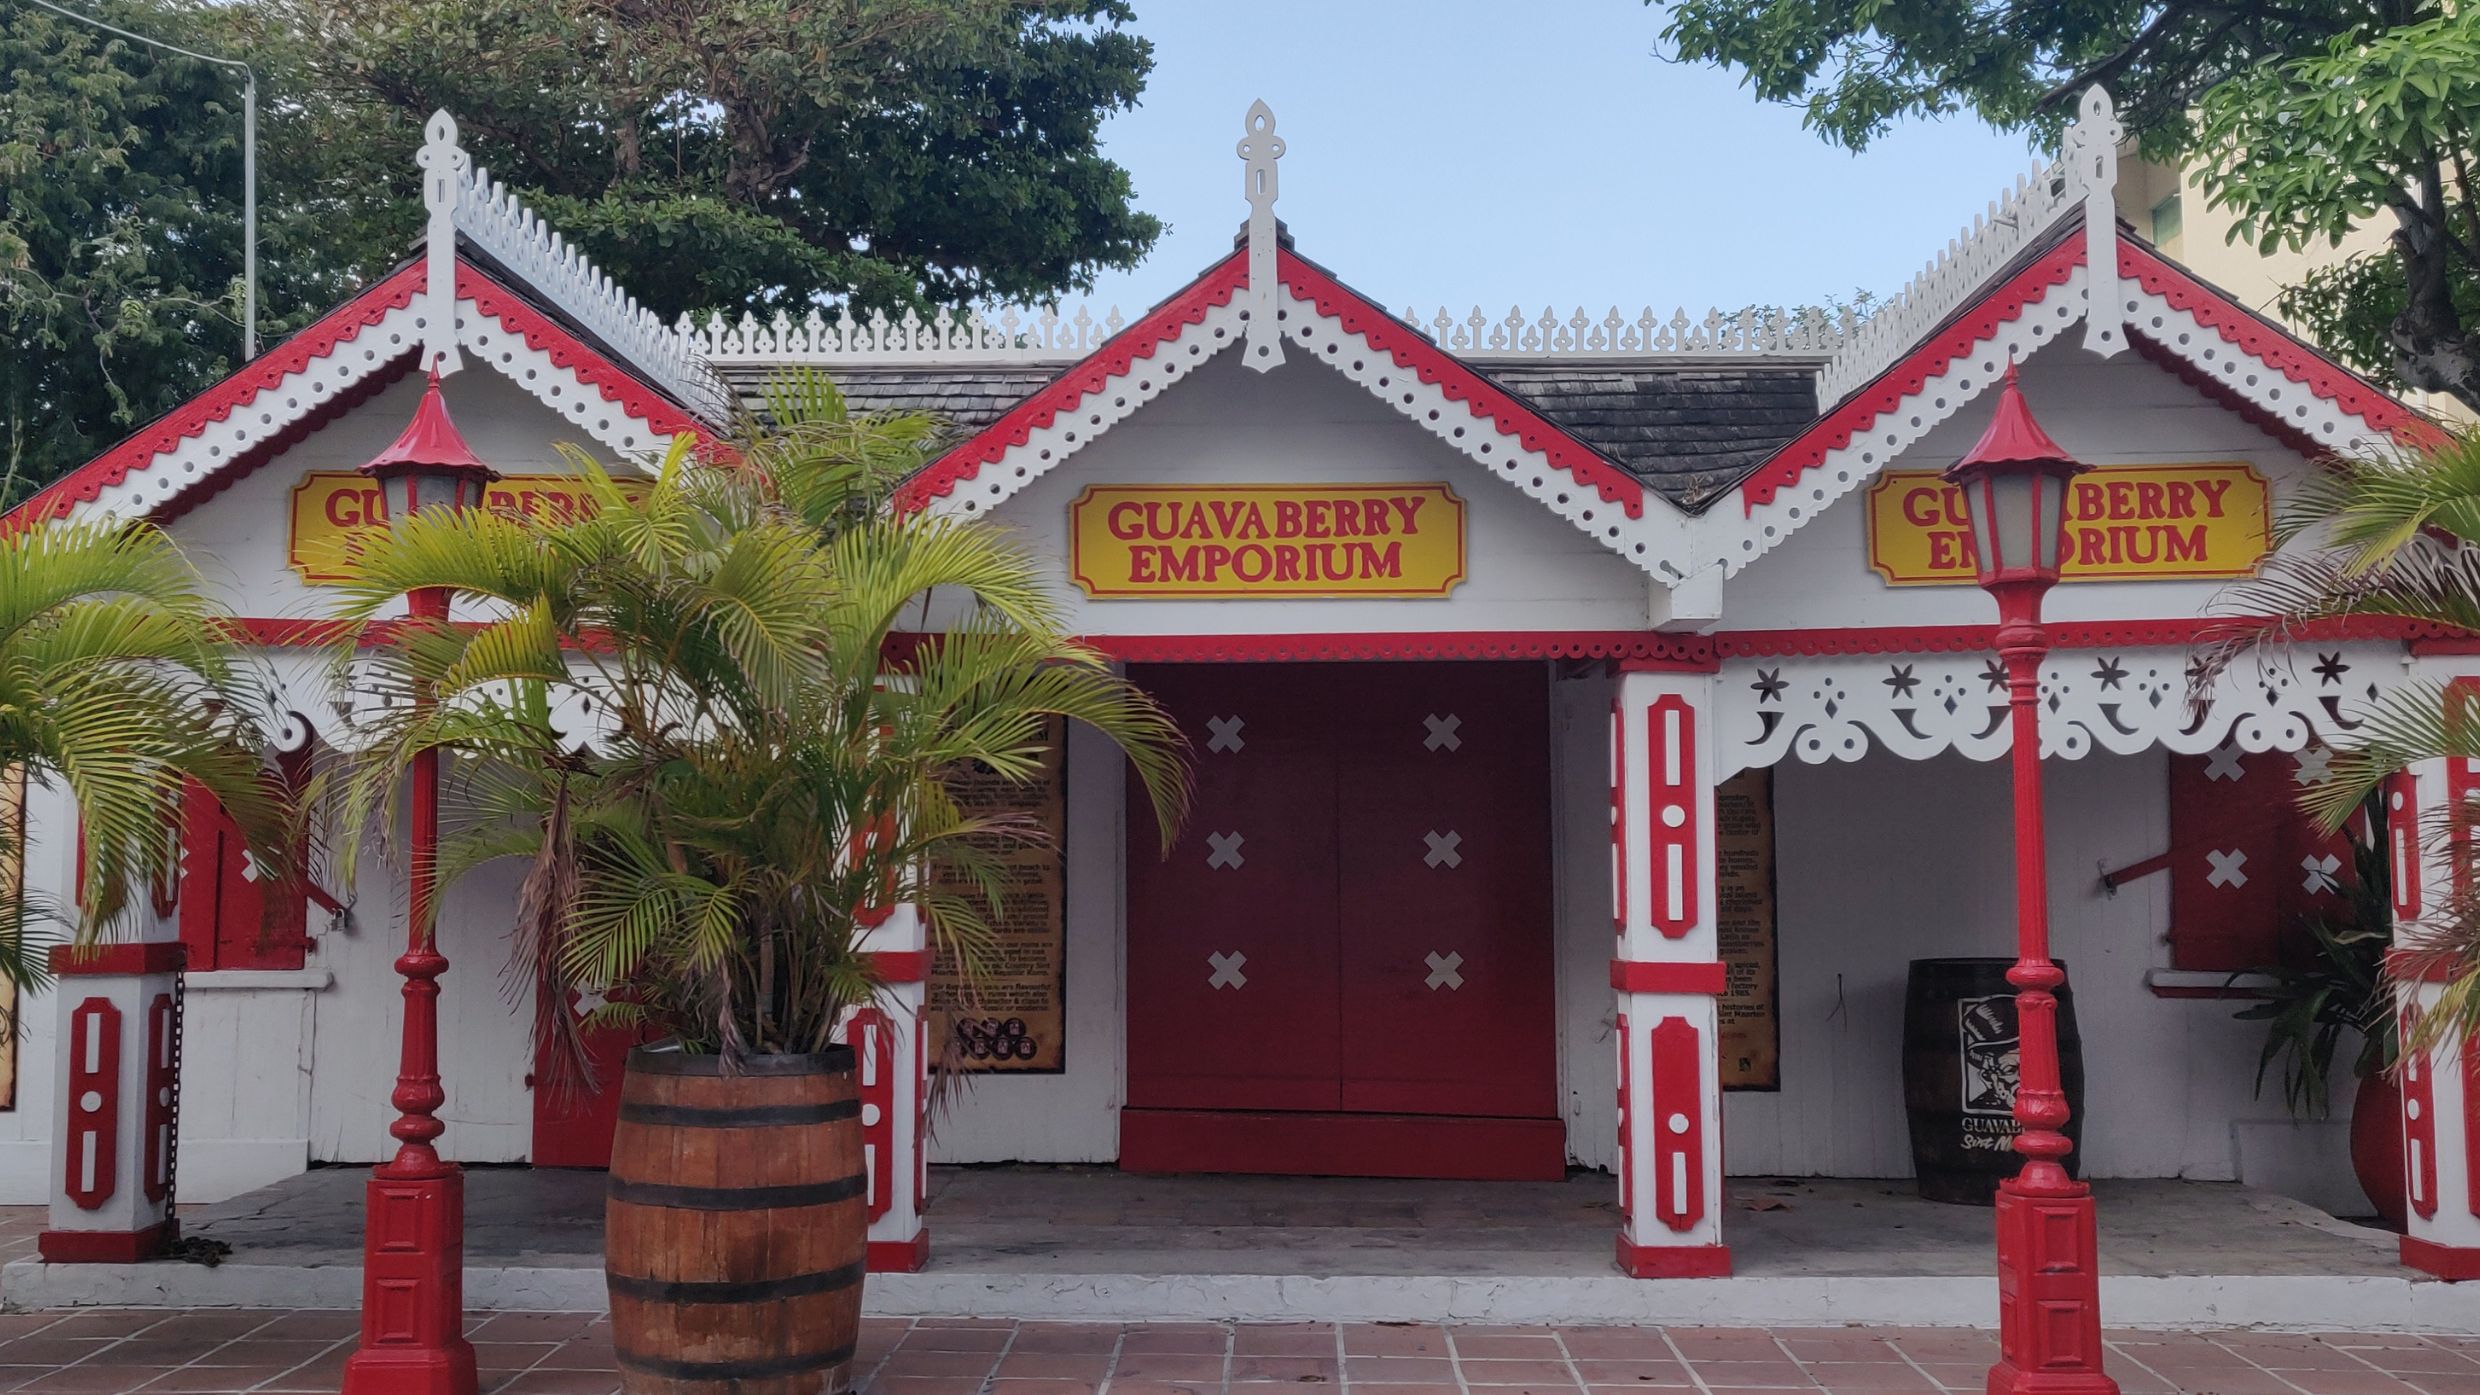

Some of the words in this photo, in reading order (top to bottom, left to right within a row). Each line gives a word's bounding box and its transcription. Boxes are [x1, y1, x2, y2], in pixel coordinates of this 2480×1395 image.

[1107, 496, 1426, 540] GUAVABERRY
[1902, 479, 2232, 527] GUBERRY
[1128, 541, 1403, 584] EMPORIUM
[1927, 525, 2209, 570] ERIUM
[1962, 1117, 2025, 1133] GUAVAB
